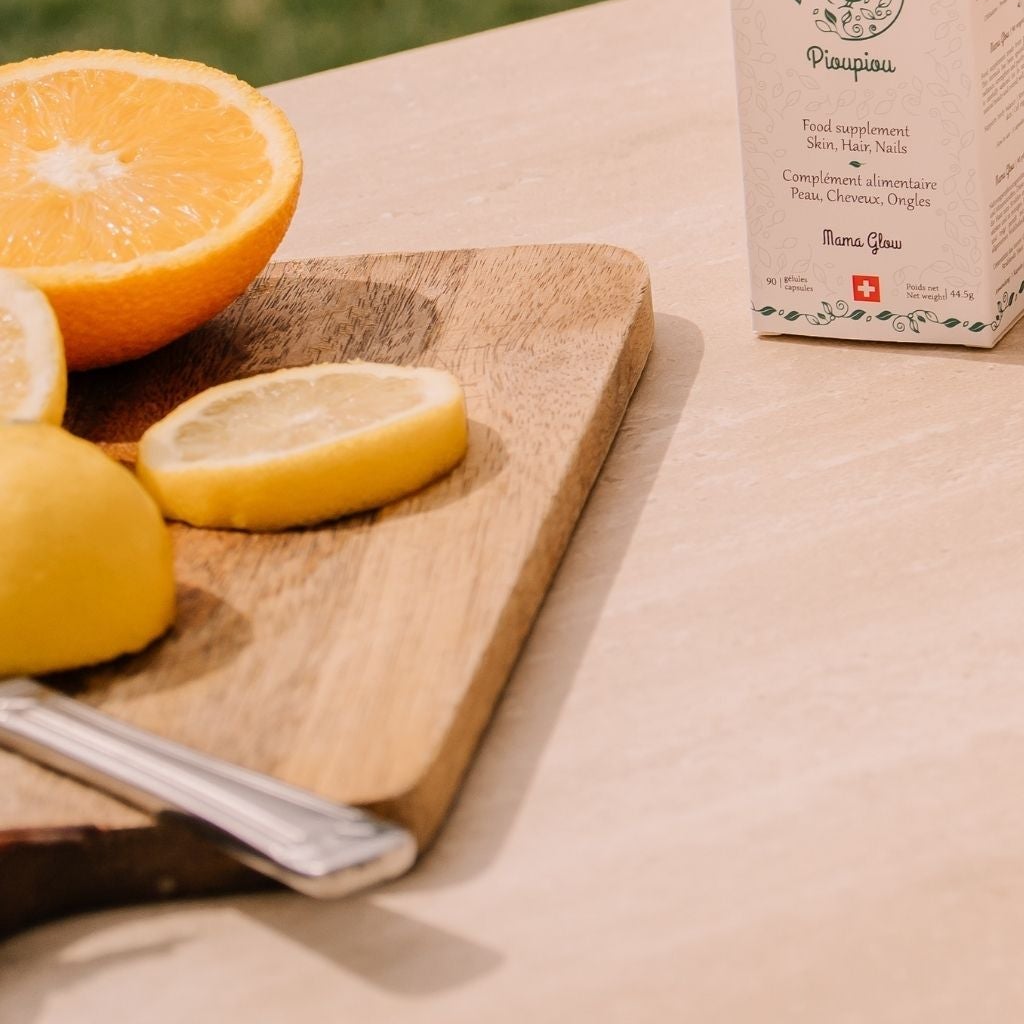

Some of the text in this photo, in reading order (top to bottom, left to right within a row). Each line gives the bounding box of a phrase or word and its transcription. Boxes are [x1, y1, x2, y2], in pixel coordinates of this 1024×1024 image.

[807, 46, 896, 82] Pioupiou
[803, 119, 910, 140] Food supplement
[807, 137, 908, 155] Skin, Hair, Nails
[783, 169, 937, 190] Complément alimentaire
[791, 187, 931, 211] Peau, Cheveux, Ongles
[823, 229, 902, 255] Mama Glow
[766, 277, 777, 286] 90
[785, 284, 813, 292] capsules
[906, 283, 939, 292] Poids net
[906, 291, 945, 302] Net weight
[950, 290, 975, 301] 44.5g
